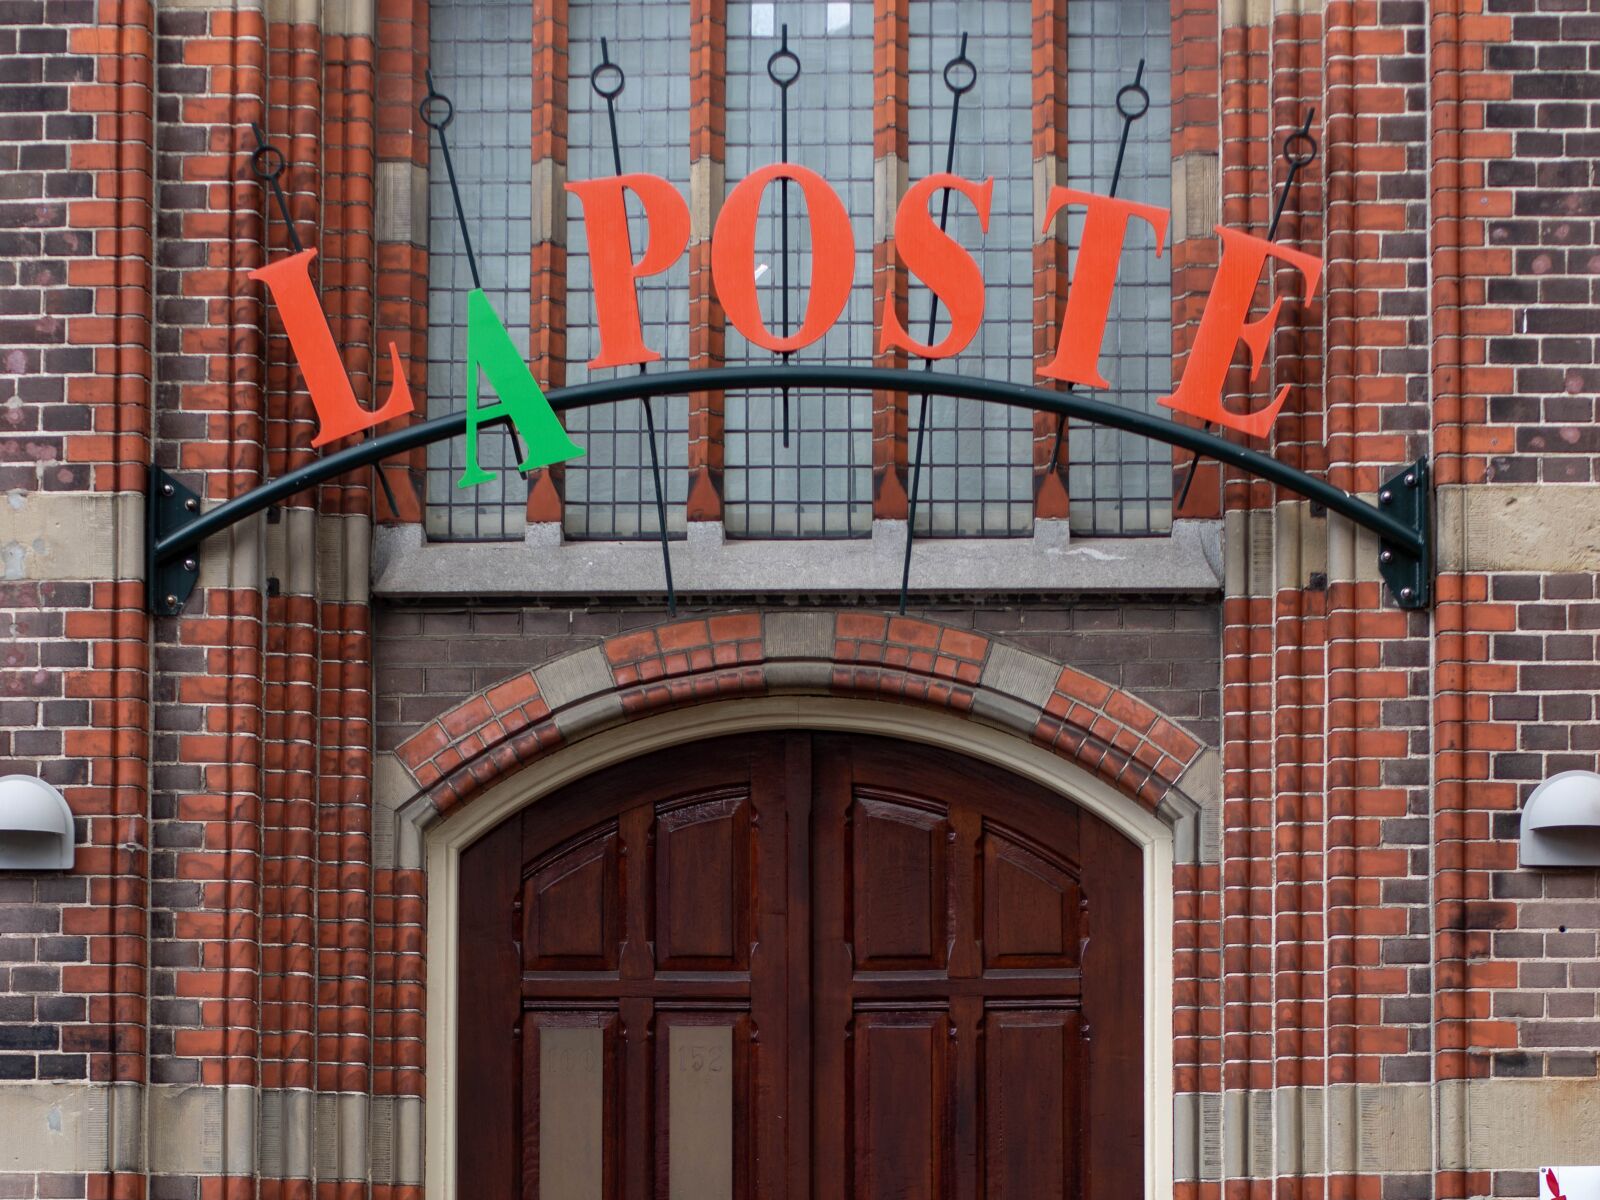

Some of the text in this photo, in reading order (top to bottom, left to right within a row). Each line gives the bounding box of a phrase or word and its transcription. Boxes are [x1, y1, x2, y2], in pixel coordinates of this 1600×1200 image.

[248, 163, 1323, 488] LA POSTE
[678, 1045, 723, 1072] 152
